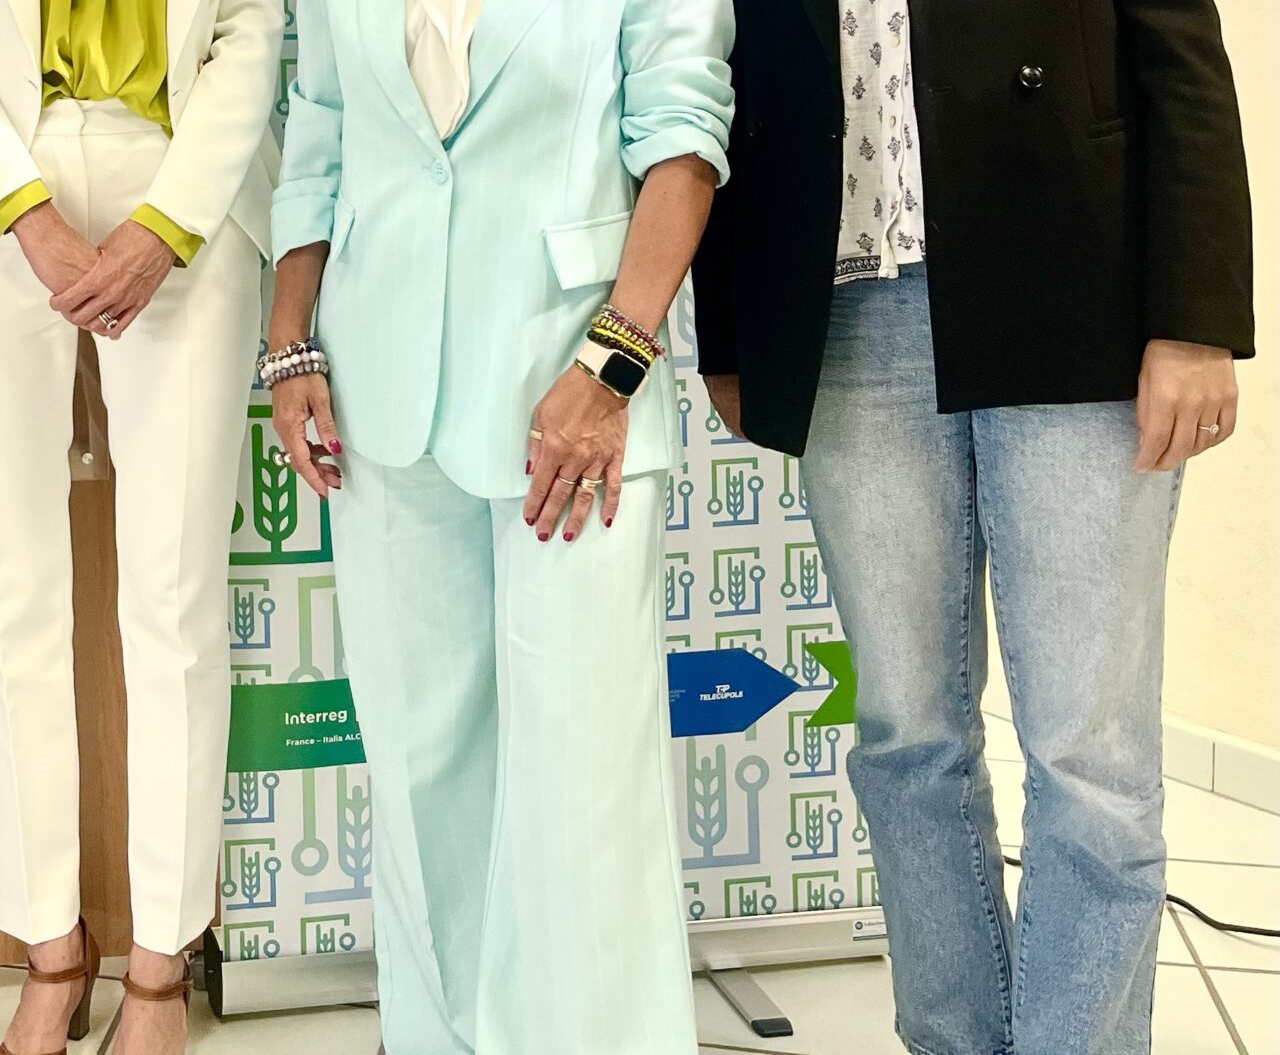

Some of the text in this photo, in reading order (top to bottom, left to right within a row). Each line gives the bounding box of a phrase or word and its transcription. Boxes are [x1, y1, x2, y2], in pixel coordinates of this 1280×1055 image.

[699, 691, 744, 701] TELECUPOLE
[284, 709, 348, 726] Interreg
[322, 734, 343, 744] Italia
